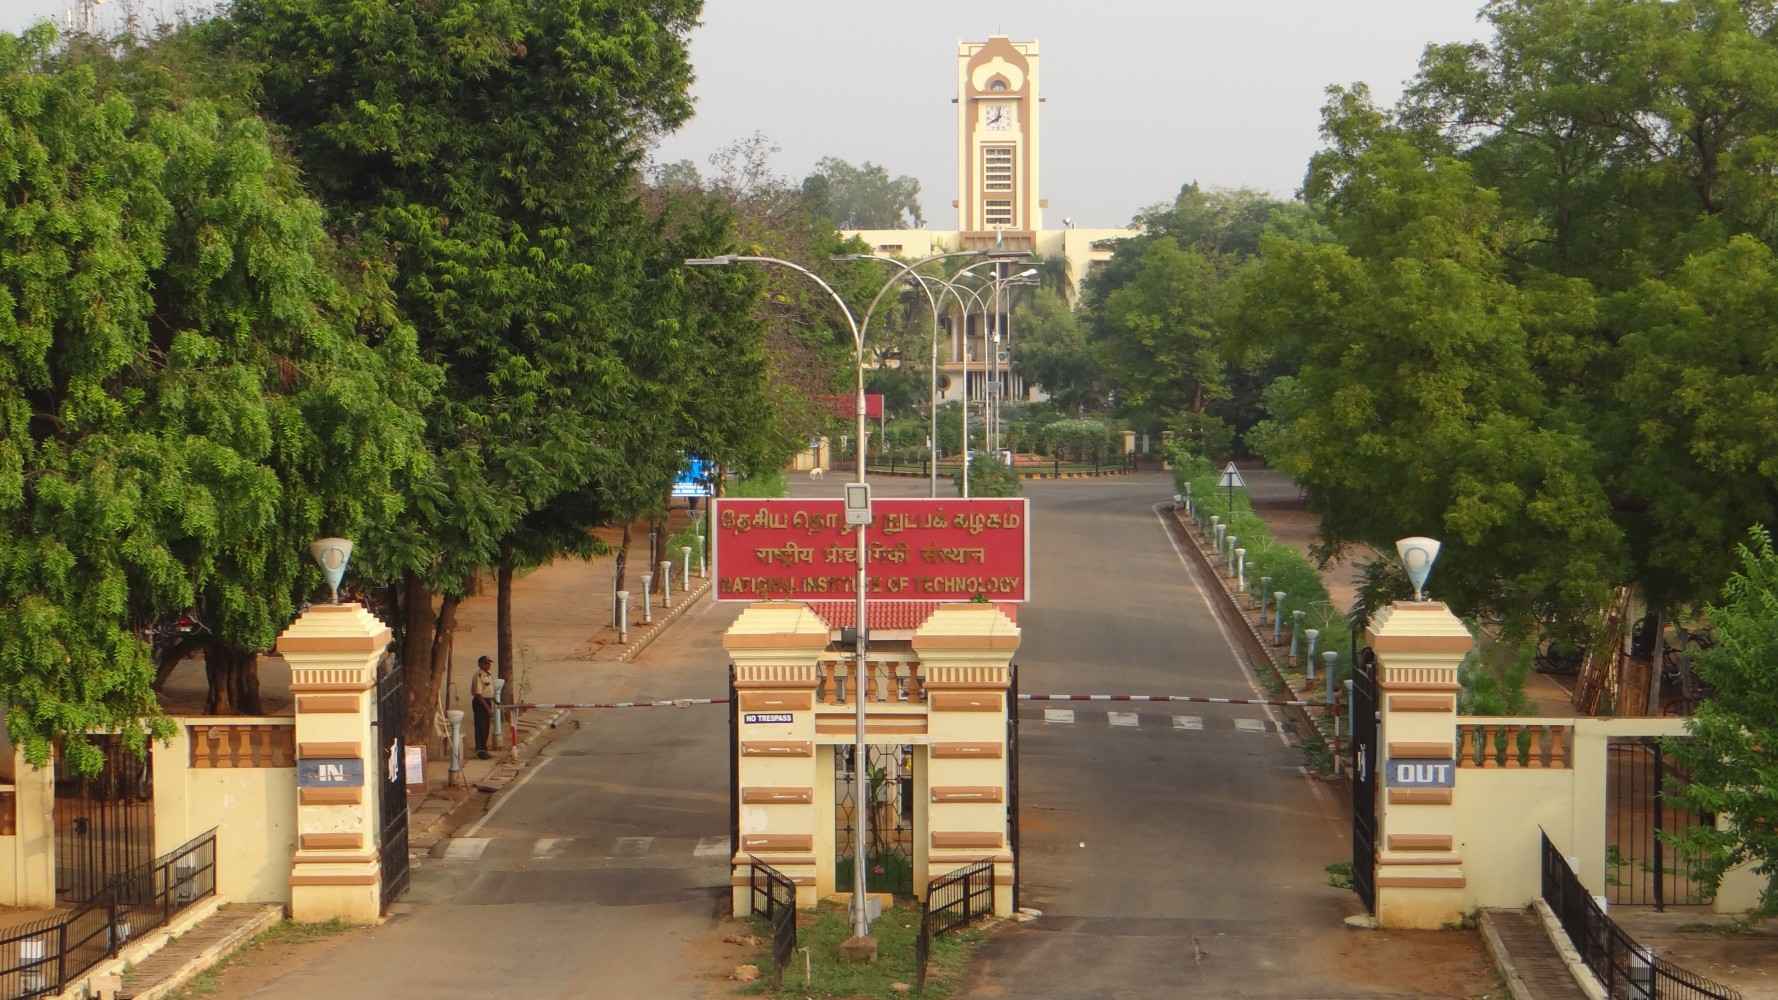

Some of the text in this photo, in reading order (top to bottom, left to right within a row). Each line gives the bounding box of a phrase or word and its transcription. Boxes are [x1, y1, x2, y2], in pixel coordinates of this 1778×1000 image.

[720, 576, 800, 594] NATIONAL
[888, 576, 909, 593] OF
[914, 576, 1020, 593] TECHNOLOGY
[757, 714, 792, 722] TRESPASS
[318, 764, 345, 782] IN
[1397, 764, 1450, 783] OUT
